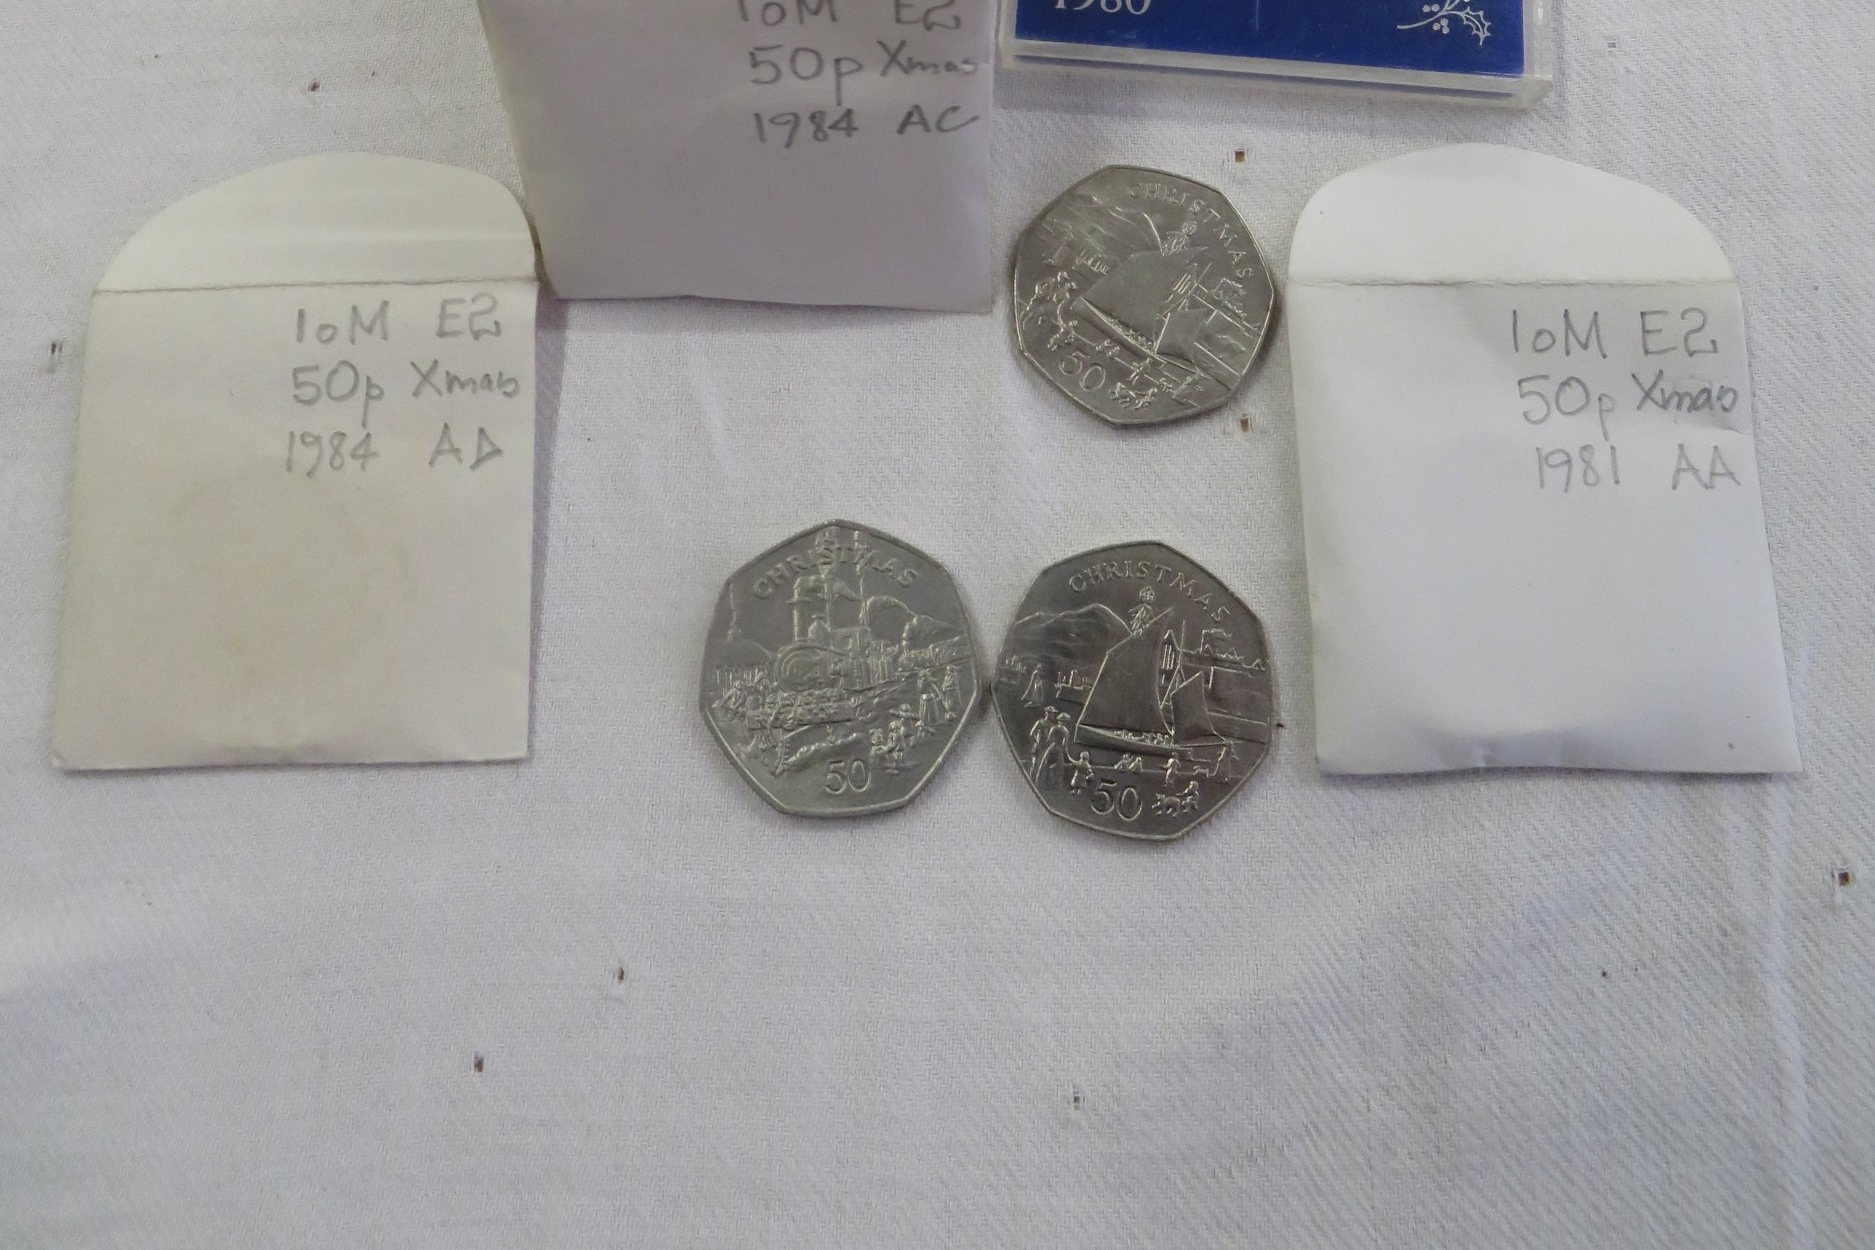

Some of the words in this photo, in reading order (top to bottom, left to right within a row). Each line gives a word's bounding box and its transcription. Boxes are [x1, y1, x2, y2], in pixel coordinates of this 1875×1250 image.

[749, 44, 864, 106] 50p
[876, 39, 979, 77] Xmas
[753, 108, 859, 149] 1984
[896, 104, 981, 135] AC
[1126, 181, 1255, 281] CHRISTMAS
[436, 291, 502, 341] E2
[1639, 306, 1719, 358] E2
[291, 359, 386, 430] 50p
[1058, 351, 1108, 393] 50
[1516, 373, 1616, 442] 50p
[286, 430, 380, 478] 1984
[428, 421, 504, 472] AD
[1535, 443, 1621, 494] 1981
[1671, 442, 1742, 491] AA
[752, 546, 920, 600] CHRISTMAS
[1068, 559, 1231, 623] CHRISTMAS
[824, 757, 873, 796] 50
[1089, 778, 1144, 823] 50
